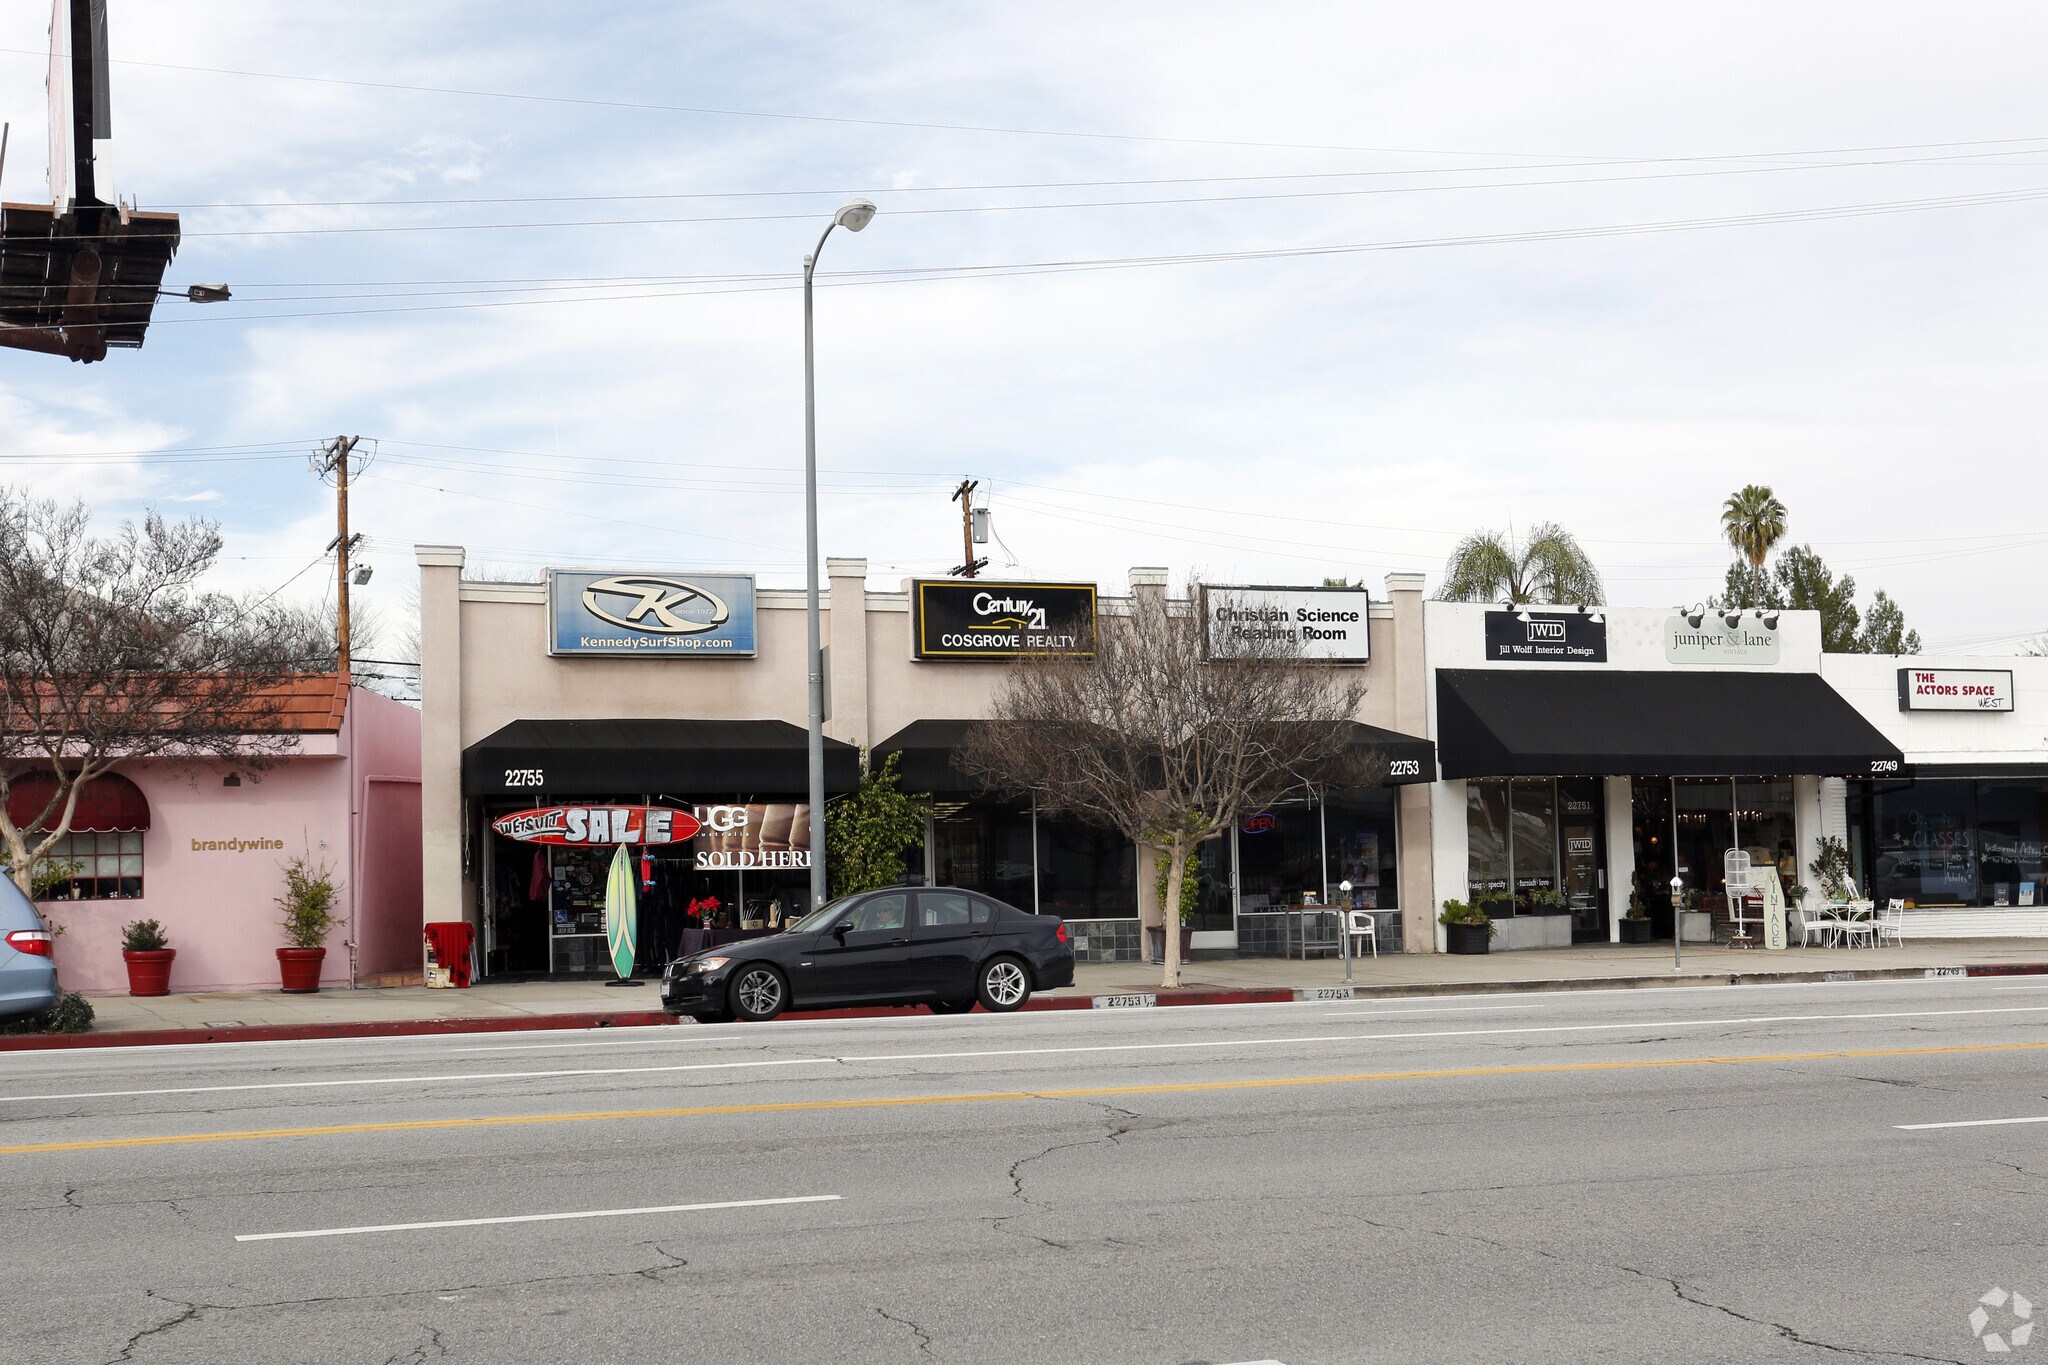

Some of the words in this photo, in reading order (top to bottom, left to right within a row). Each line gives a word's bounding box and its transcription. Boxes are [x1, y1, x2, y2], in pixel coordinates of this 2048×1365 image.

[973, 592, 1033, 616] Century
[1027, 608, 1046, 630] 21
[1216, 607, 1289, 623] Christian
[1296, 608, 1360, 623] Science
[1231, 625, 1297, 643] Reading
[1302, 626, 1347, 641] Room
[1529, 623, 1564, 640] JWID
[580, 636, 733, 649] KennedySurfShop.com
[941, 633, 1020, 648] COSGROVE
[1027, 635, 1077, 648] REALTY
[1672, 630, 1723, 650] juniper
[1727, 631, 1741, 647] &
[1744, 630, 1772, 647] lane
[1499, 644, 1511, 656] Jill
[1512, 645, 1533, 655] Wolff
[1535, 645, 1565, 655] Interior
[1567, 646, 1595, 657] Design
[1723, 648, 1748, 656] VINTAGE
[1915, 672, 1935, 683] THE
[1916, 684, 1959, 696] ACTORS
[1962, 685, 1995, 697] SPACE
[1977, 697, 2005, 709] WEST
[1390, 759, 1420, 776] 22753
[1870, 760, 1898, 772] 22749
[504, 768, 544, 787] 22755
[1567, 801, 1591, 810] 22751
[499, 809, 564, 836] WETSUIT
[564, 808, 673, 844] SALE
[694, 805, 749, 832] UGG
[1243, 816, 1276, 831] OPEN
[191, 836, 284, 853] brandywine
[1569, 840, 1592, 851] JWID
[1913, 831, 1970, 848] CLASSES
[696, 851, 755, 868] SOLD
[1770, 875, 1780, 947] VINTAGE
[1107, 996, 1141, 1007] 22753
[1317, 988, 1349, 999] 22753
